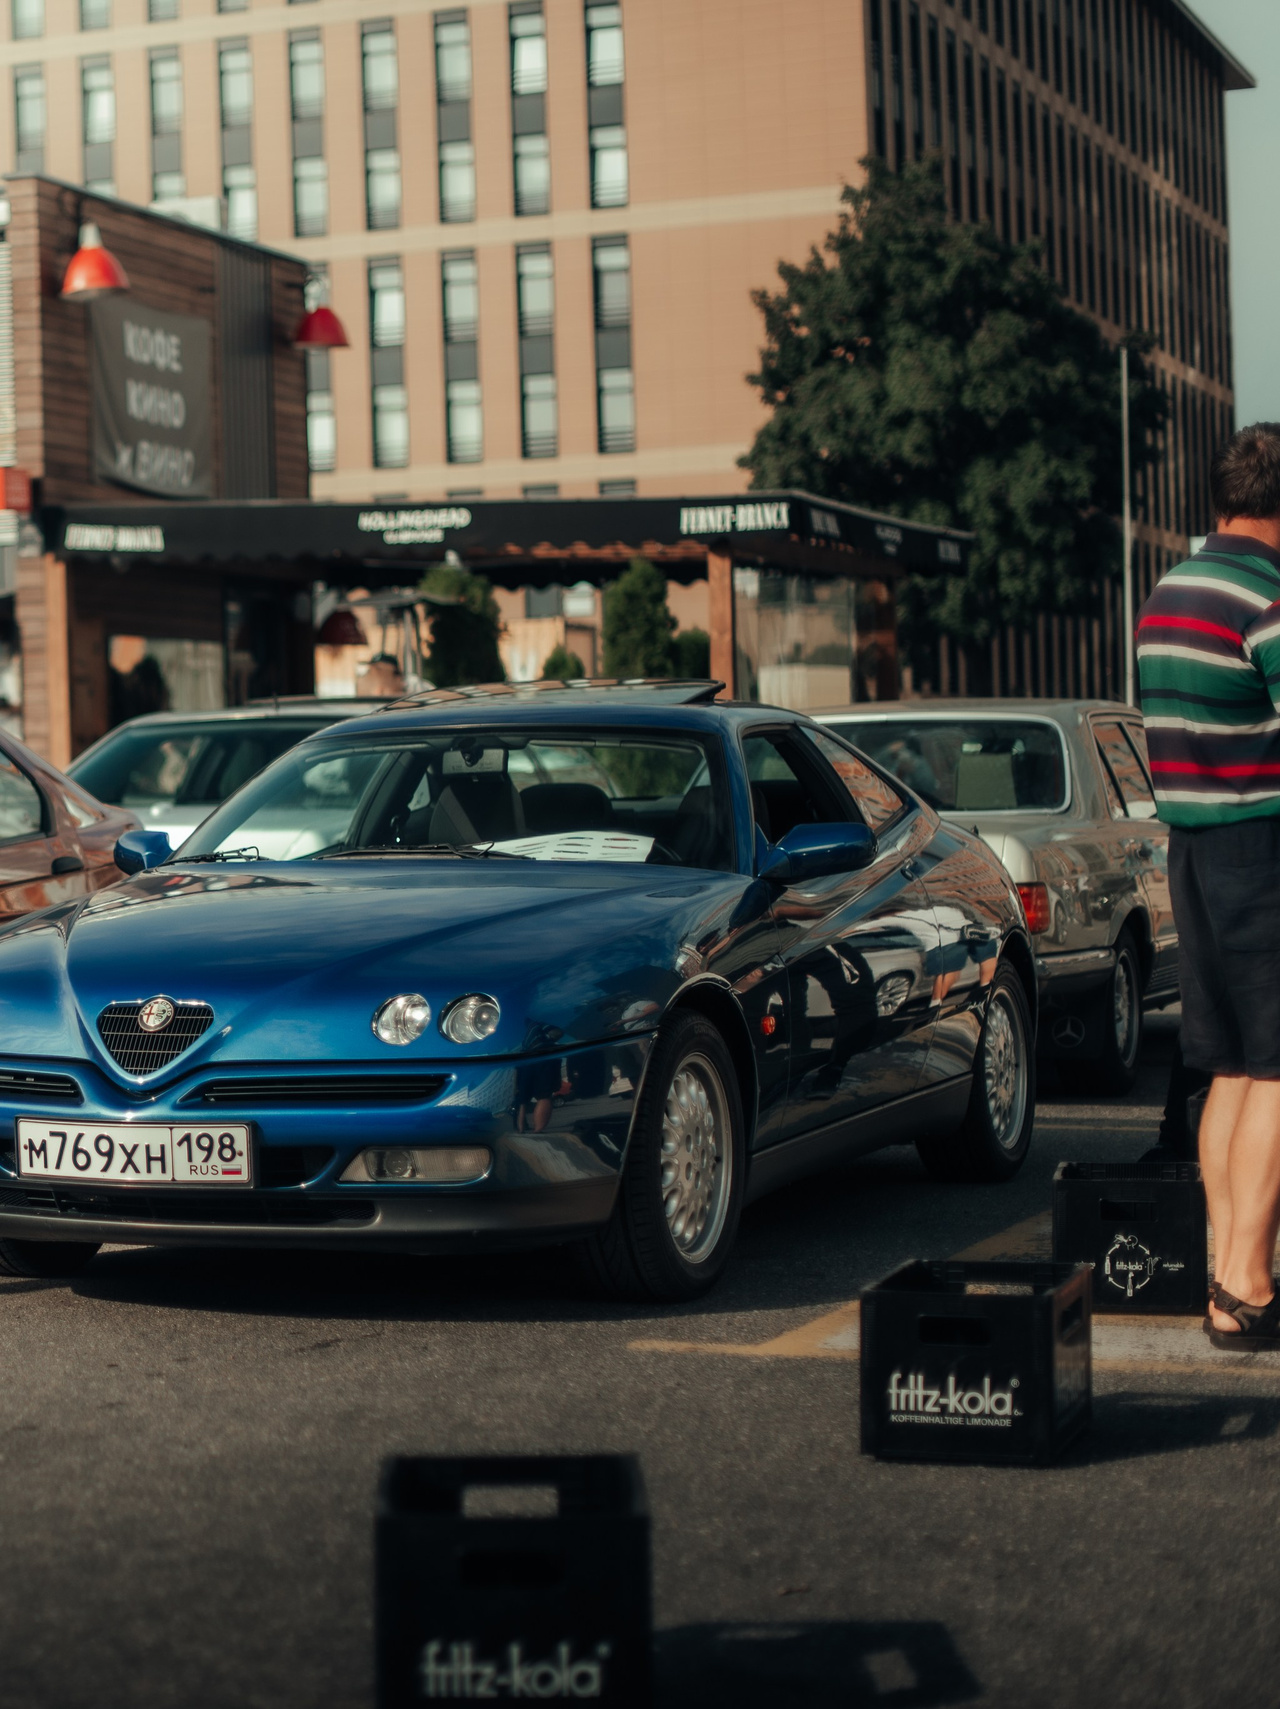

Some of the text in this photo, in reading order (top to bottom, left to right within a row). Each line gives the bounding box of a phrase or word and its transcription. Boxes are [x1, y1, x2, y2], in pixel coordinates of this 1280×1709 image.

[123, 320, 183, 374] КОФЕ
[126, 378, 187, 430] КИНО
[28, 1131, 236, 1175] M769XH 198
[189, 1165, 219, 1176] RUS
[889, 1372, 1013, 1416] fritz-kola
[891, 1414, 1012, 1427] KOFFEINHALTIGE LIMONADE
[422, 1639, 601, 1697] fritz-kola
